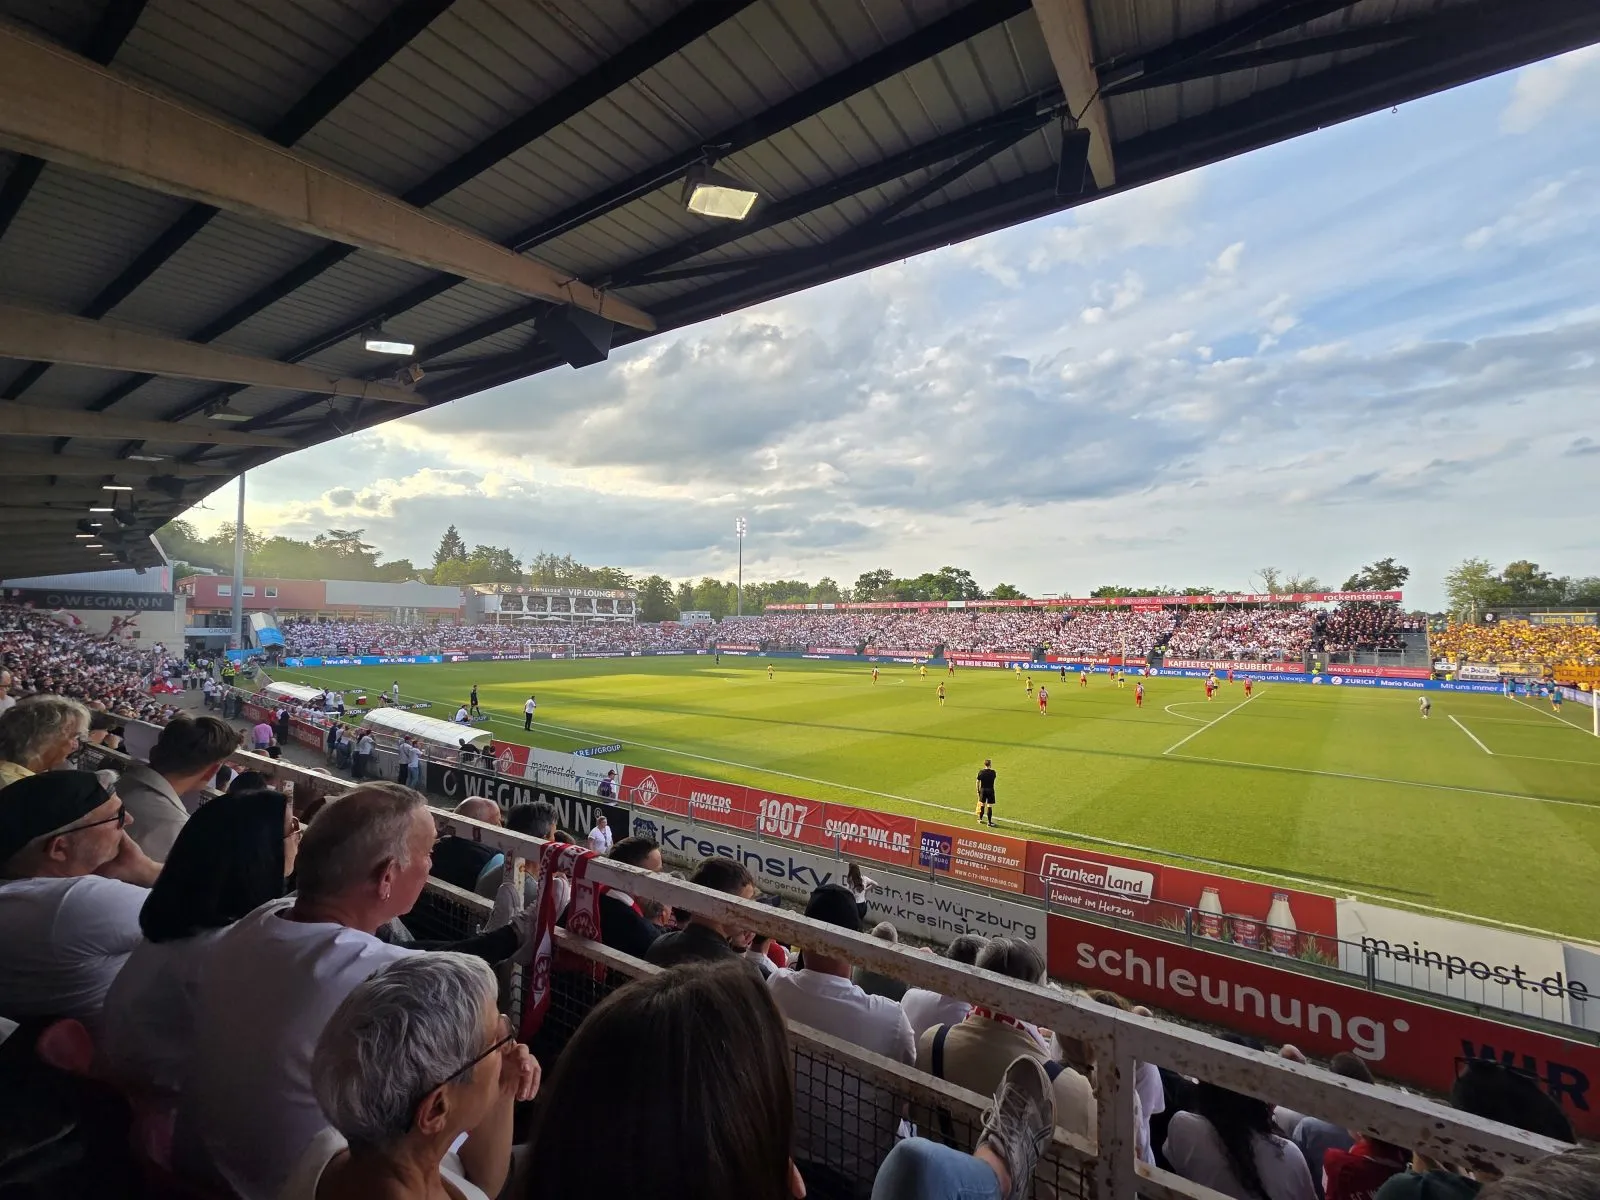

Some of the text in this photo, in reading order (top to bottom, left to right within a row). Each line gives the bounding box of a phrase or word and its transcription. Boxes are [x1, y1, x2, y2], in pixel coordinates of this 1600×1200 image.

[66, 595, 163, 608] WEGMANN
[583, 589, 616, 598] LOUNGE
[1323, 593, 1394, 601] rockenstein.de
[1057, 656, 1110, 664] magnet-shop.net
[1168, 660, 1284, 672] KAFFEETECHNIK-SEUBERT.de
[1440, 682, 1454, 690] Mit
[1472, 684, 1498, 692] immer
[690, 791, 732, 814] KICKERS
[758, 798, 808, 839] 1907
[921, 838, 941, 848] CITY
[957, 838, 1007, 855] ALLES AUS DER
[661, 825, 833, 888] Kresinsky
[956, 847, 1021, 867] SCHÖNSTEN STADT
[1048, 862, 1143, 893] Franken Land
[1051, 889, 1135, 917] Heimat im Herzen
[1362, 933, 1589, 1001] mainpost.de
[1076, 942, 1386, 1061] schleunung
